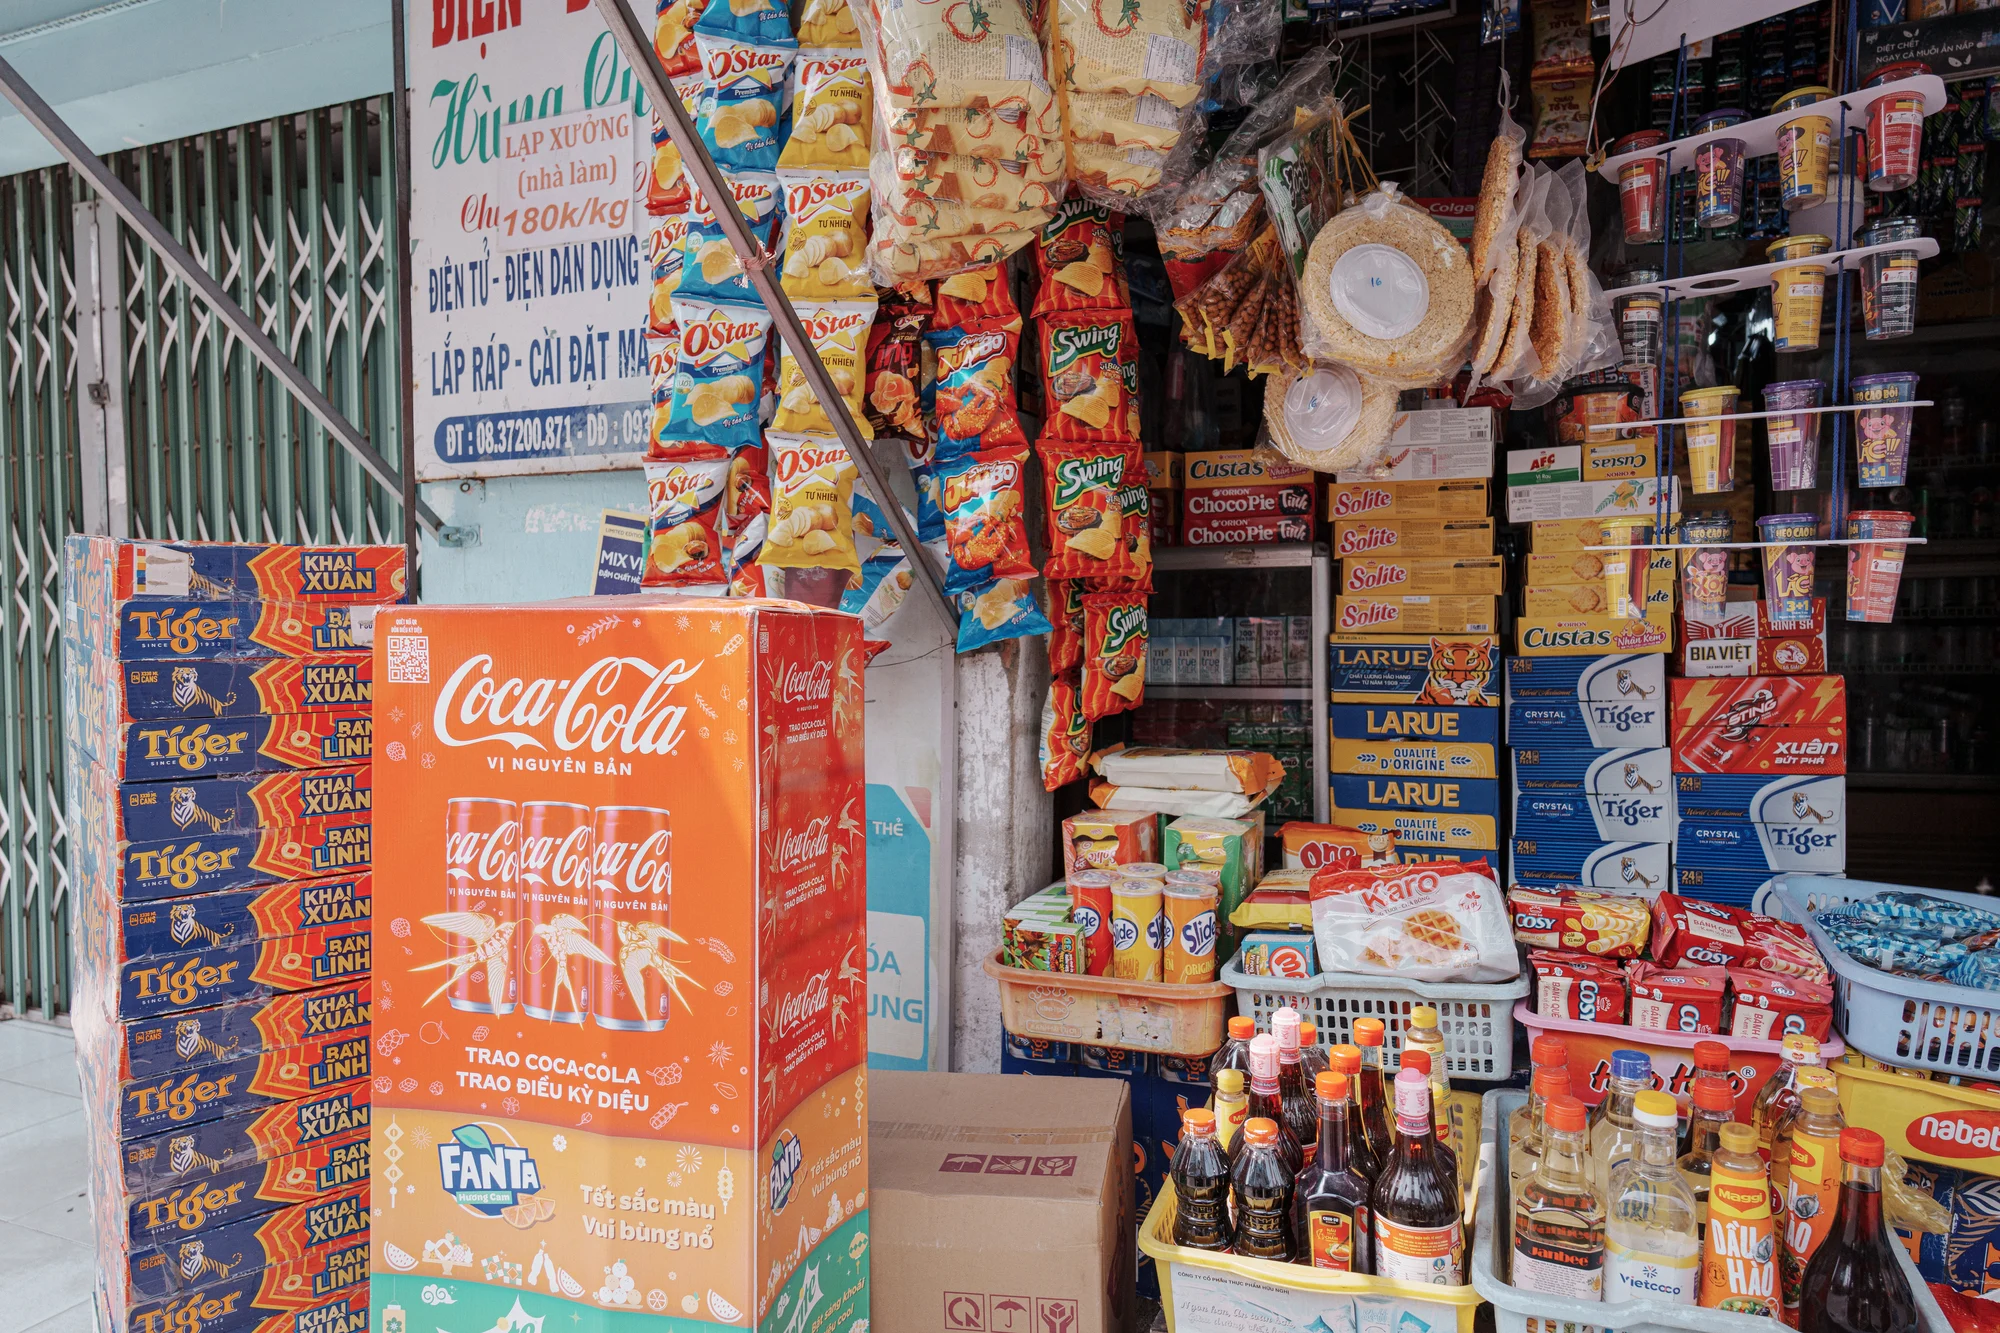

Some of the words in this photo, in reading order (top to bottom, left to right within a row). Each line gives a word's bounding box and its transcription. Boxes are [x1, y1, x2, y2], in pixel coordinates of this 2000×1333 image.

[1876, 52, 1900, 64] NGAY
[734, 86, 760, 96] Premium
[505, 130, 544, 162] LẠP
[550, 113, 630, 151] XƯỞNG
[517, 163, 564, 199] (nhà
[570, 154, 617, 186] làm)
[788, 176, 864, 214] O'Star
[503, 197, 629, 237] 180k/kg
[818, 218, 828, 229] TỰ
[830, 218, 852, 229] NHIÊN
[428, 254, 465, 322] ĐIỆN
[469, 236, 490, 308] TỬ
[591, 235, 639, 302] DỤNG
[1369, 276, 1383, 288] 16
[683, 320, 760, 357] O'Star
[1056, 327, 1120, 363] Swing
[431, 331, 466, 396] LẮP
[472, 332, 510, 393] RÁP
[529, 326, 562, 388] CÀI
[569, 324, 610, 391] ĐẶT
[711, 363, 738, 375] Premium
[476, 414, 572, 456] 08.37200.871
[1190, 459, 1264, 480] Custas
[1530, 453, 1556, 471] AFC
[1060, 457, 1124, 498] Swing
[1221, 488, 1250, 497] ORION
[1333, 488, 1392, 517] Solite
[304, 554, 353, 573] KHAI
[600, 549, 629, 569] MIX
[306, 570, 372, 591] XUÂN
[1347, 562, 1407, 592] Solite
[1786, 600, 1809, 612] 3+1
[129, 607, 240, 654] Tiger
[1523, 627, 1611, 649] Custas
[1338, 649, 1428, 666] LARUE
[1690, 644, 1718, 661] BIA
[1718, 641, 1752, 663] VIỆT
[1512, 659, 1525, 669] 24
[141, 675, 158, 684] CANS
[306, 667, 354, 684] KHAI
[306, 681, 372, 702] XUÂN
[1366, 710, 1459, 736] LARUE
[1524, 710, 1566, 719] CRYSTAL
[1594, 704, 1655, 732] Tiger
[1728, 700, 1777, 726] STING
[138, 723, 248, 770] Tiger
[1393, 746, 1437, 759] QUALITÉ
[487, 756, 505, 773] VỊ
[513, 757, 586, 774] NGUYÊN
[594, 757, 633, 776] BẢN
[1380, 758, 1445, 771] D'ORIGINE
[1775, 755, 1800, 765] BỨT
[305, 777, 352, 795] KHAI
[1367, 780, 1460, 807] LARUE
[305, 792, 371, 814] XUÂN
[1602, 798, 1663, 826] Tiger
[330, 826, 370, 845] BẢN
[872, 817, 904, 837] THẺ
[1696, 829, 1741, 839] CRYSTAL
[1771, 825, 1838, 855] Tiger
[129, 841, 240, 889] Tiger
[315, 843, 370, 868] LĨNH
[458, 887, 498, 899] NGUYÊN
[501, 889, 517, 900] BẢN
[1362, 872, 1441, 913] Karo
[1516, 913, 1556, 930] COSY
[1682, 901, 1732, 920] COSY
[330, 935, 370, 954] BẢN
[1687, 946, 1735, 965] COSY
[315, 954, 370, 978] LĨNH
[129, 957, 240, 1005] Tiger
[1578, 979, 1600, 1022] COSY
[465, 1046, 520, 1068] TRAO
[525, 1053, 641, 1085] COCA-COLA
[128, 1073, 237, 1121] Tiger
[456, 1071, 511, 1092] TRAO
[516, 1075, 563, 1099] ĐIỀU
[568, 1081, 594, 1105] KỲ
[598, 1090, 649, 1115] DIỆU
[841, 1136, 862, 1156] màu
[440, 1145, 540, 1190] FANTA
[137, 1181, 246, 1231] Tiger
[489, 1192, 510, 1203] Cam
[580, 1183, 615, 1209] Tết
[619, 1187, 660, 1214] sắc
[664, 1196, 716, 1220] màu
[1717, 1187, 1764, 1204] Maggi
[1322, 1216, 1340, 1224] CHIN-SU
[582, 1215, 615, 1241] Vui
[619, 1218, 682, 1251] bùng
[684, 1224, 715, 1250] nổ
[1711, 1218, 1758, 1257] DẦU
[1530, 1246, 1590, 1267] Janbee
[1619, 1271, 1682, 1296] Vietcoco
[1725, 1256, 1775, 1298] HÀO
